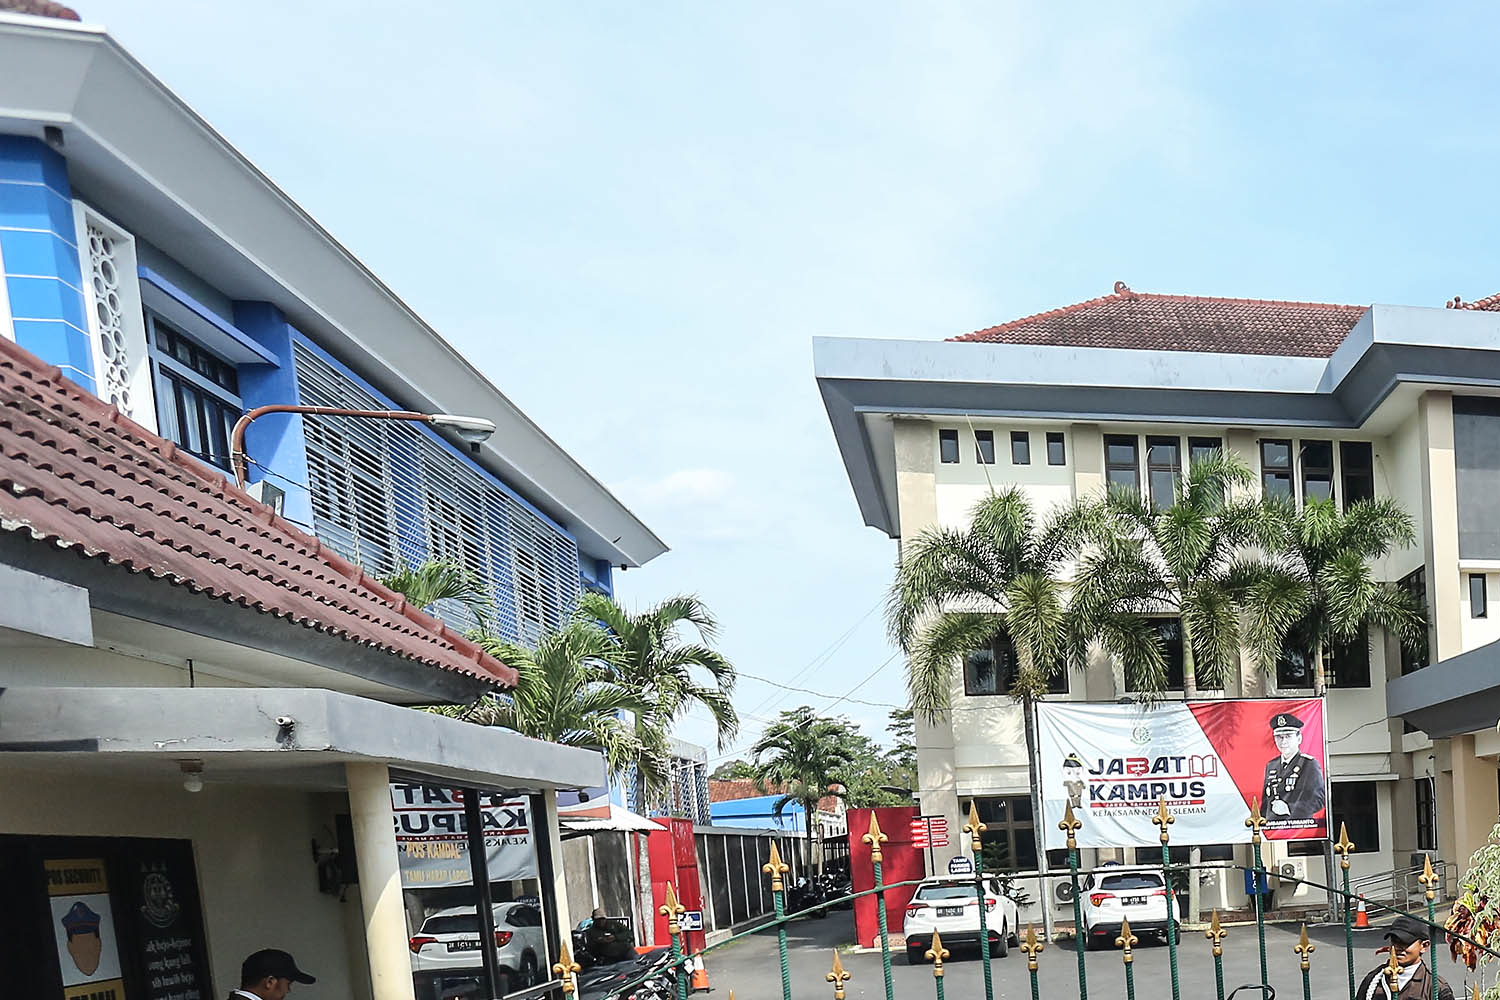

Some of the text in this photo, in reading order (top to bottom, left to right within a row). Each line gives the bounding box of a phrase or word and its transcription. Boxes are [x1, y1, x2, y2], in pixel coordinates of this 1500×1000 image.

[1088, 756, 1186, 776] JABAT
[1089, 781, 1206, 801] KAMPUS
[1173, 806, 1206, 815] SLEMAN
